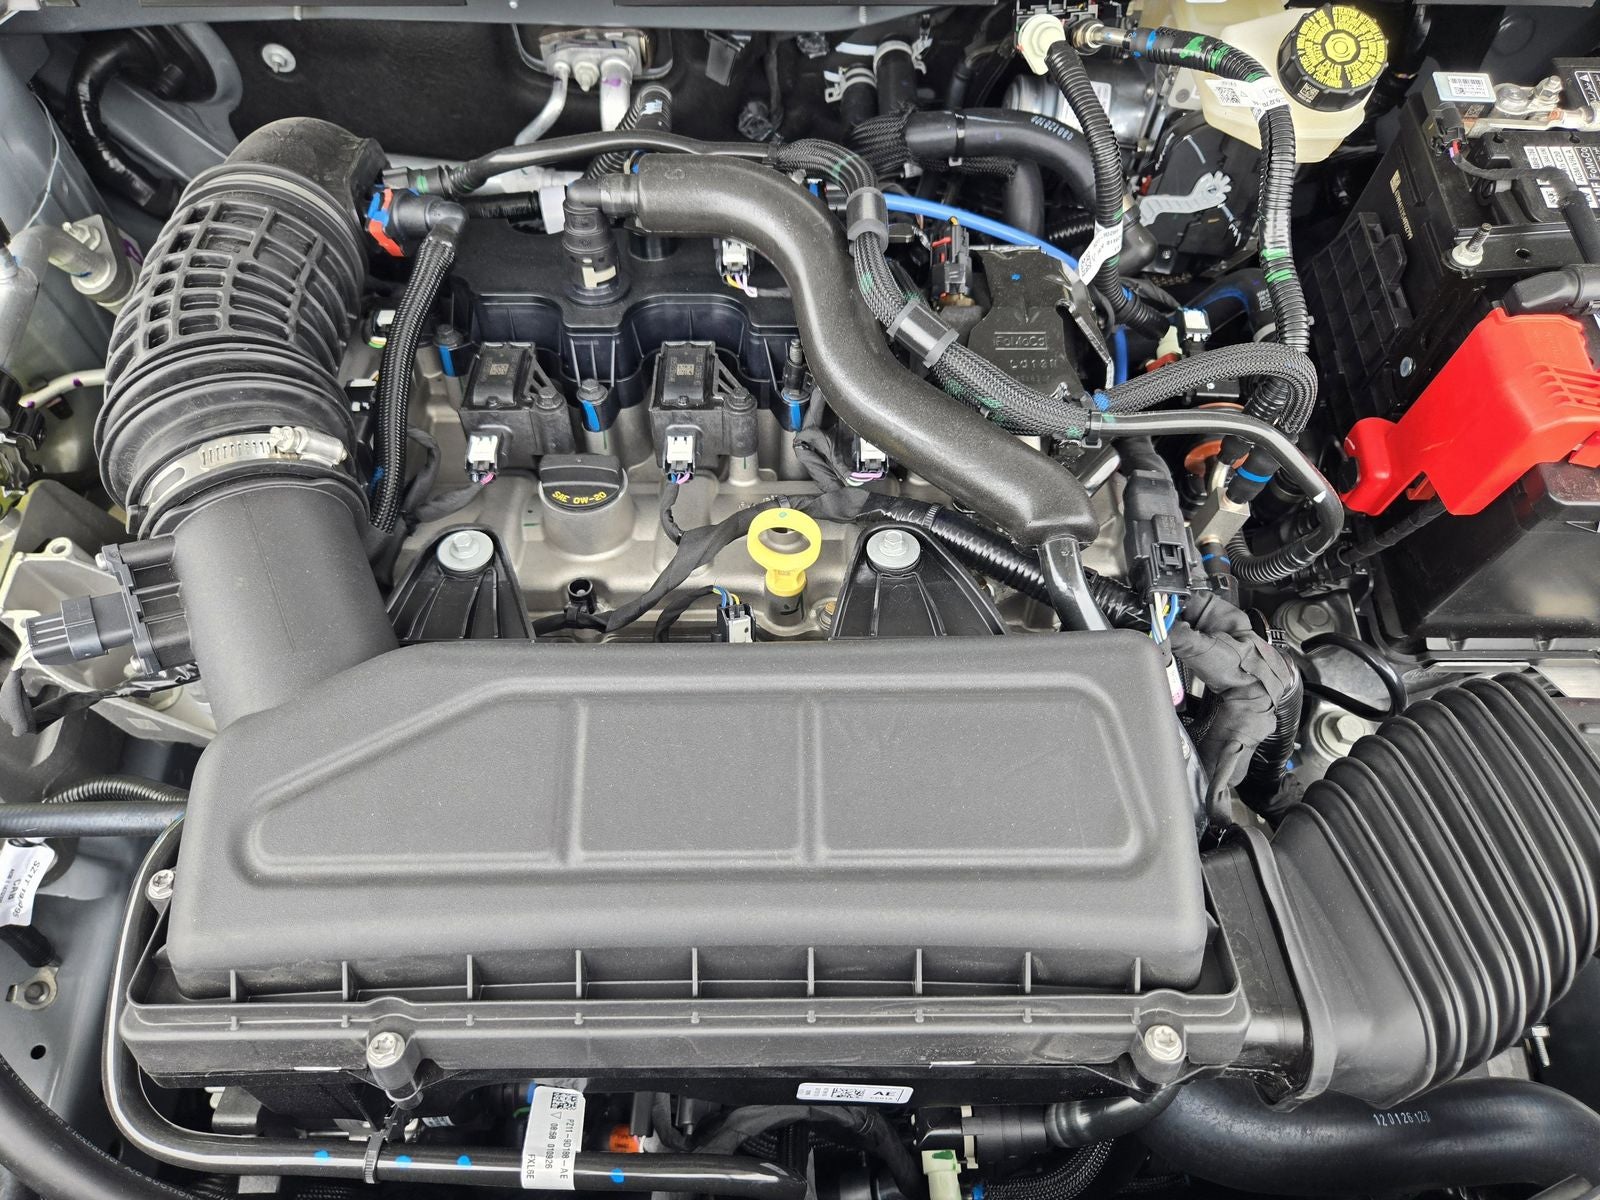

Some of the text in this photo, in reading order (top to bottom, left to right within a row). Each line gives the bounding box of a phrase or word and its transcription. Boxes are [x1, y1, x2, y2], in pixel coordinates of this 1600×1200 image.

[1580, 146, 1598, 179] FoMoCo
[552, 491, 607, 504] SAE 0W-20
